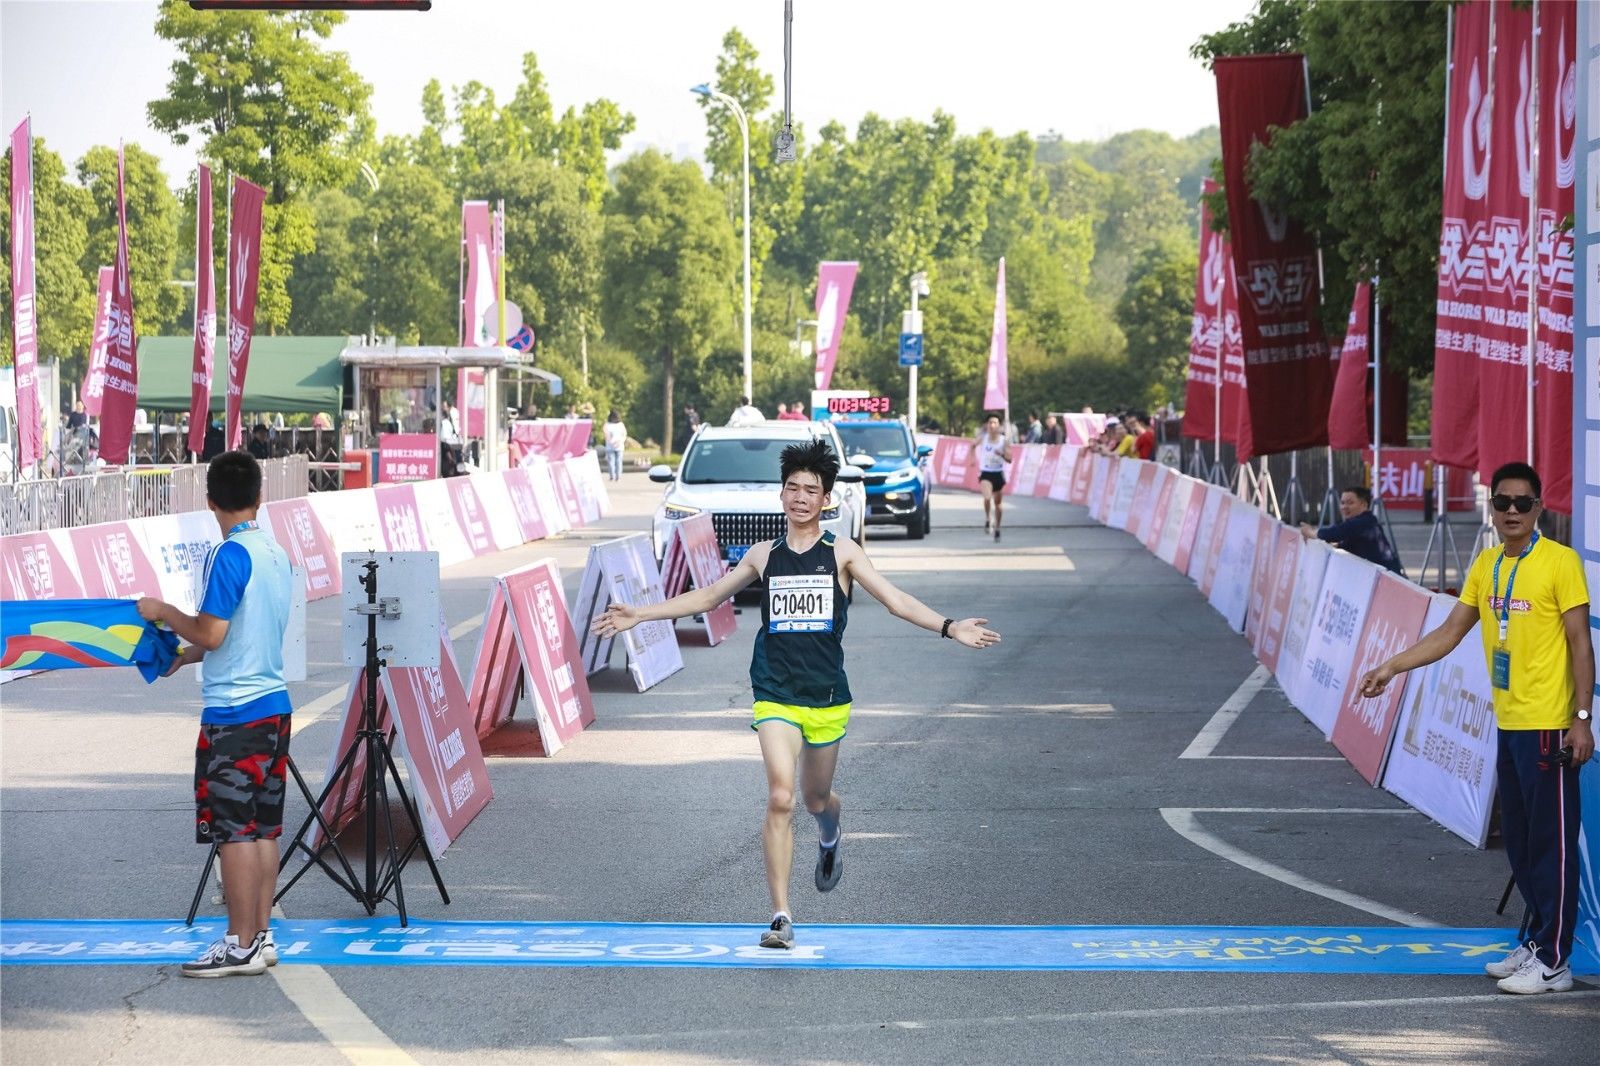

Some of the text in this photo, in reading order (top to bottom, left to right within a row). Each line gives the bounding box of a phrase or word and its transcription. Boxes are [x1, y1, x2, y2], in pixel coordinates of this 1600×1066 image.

[829, 397, 891, 413] 00:34:23
[772, 593, 823, 616] C10401
[1071, 934, 1362, 948] MARATHON
